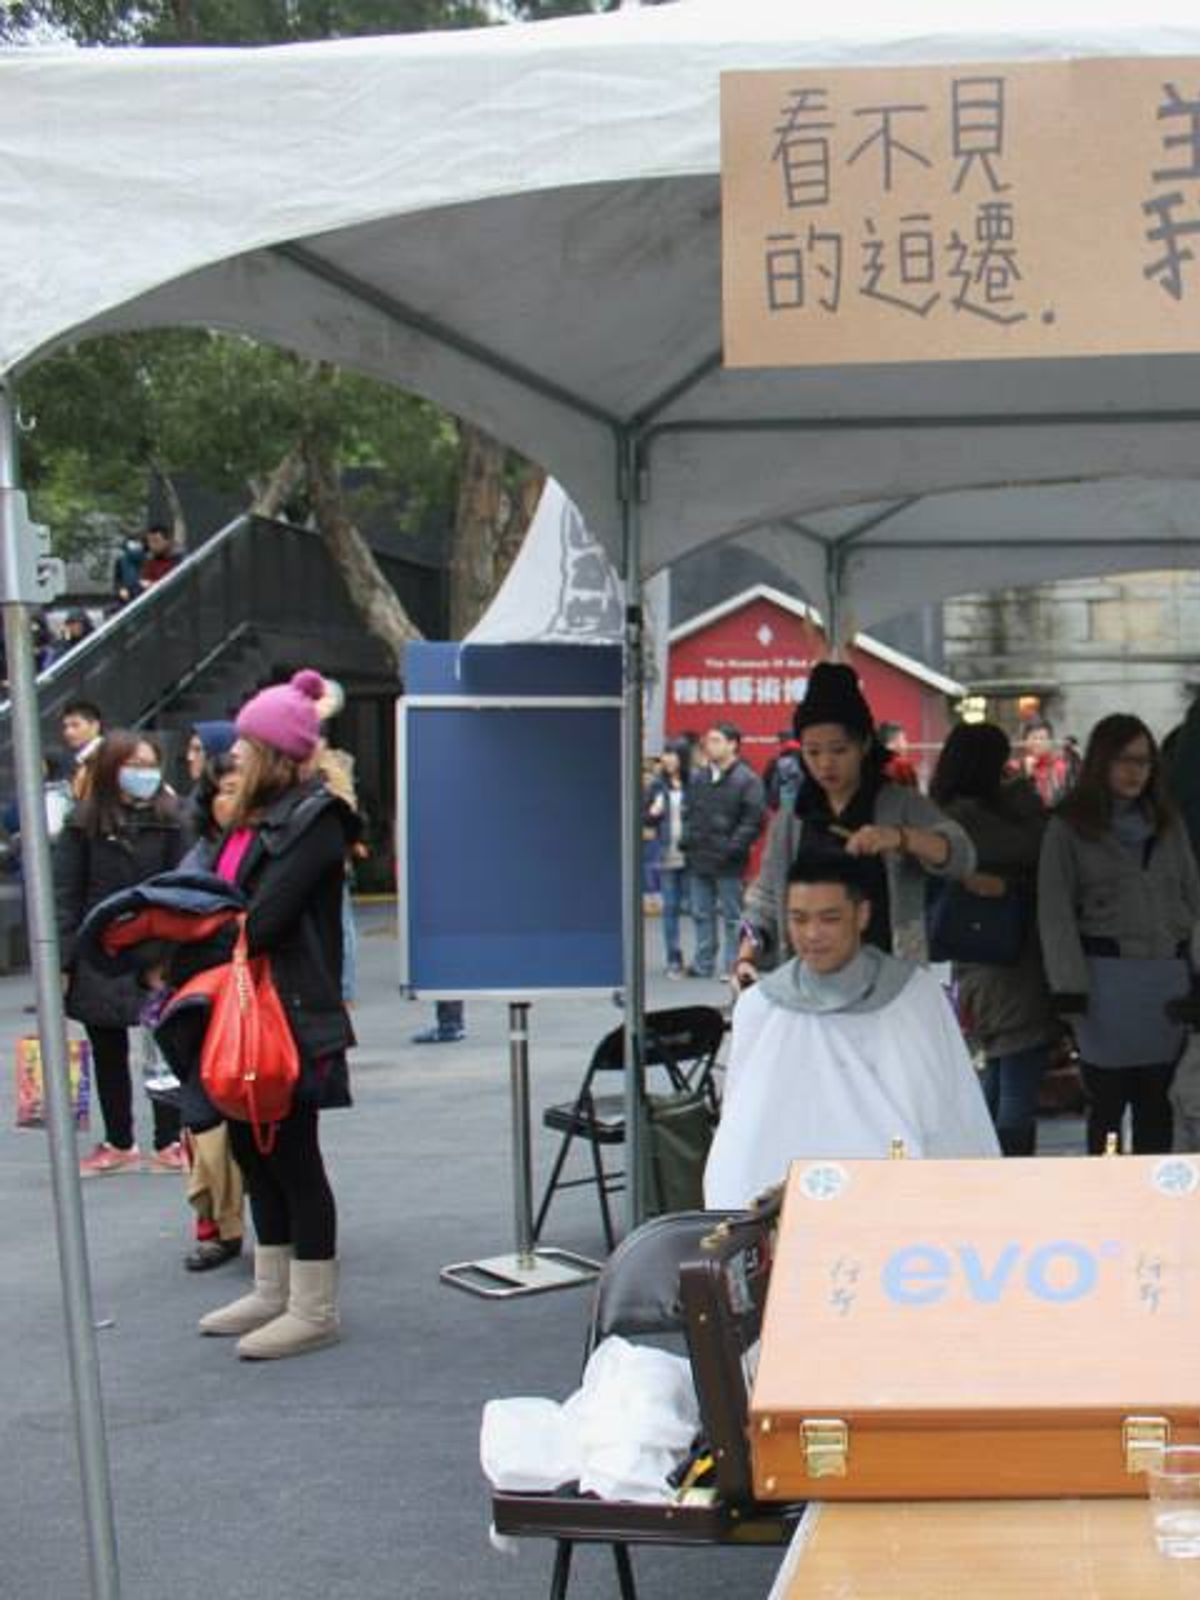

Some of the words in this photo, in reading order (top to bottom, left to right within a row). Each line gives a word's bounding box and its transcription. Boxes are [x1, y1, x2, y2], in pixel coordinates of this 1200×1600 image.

[772, 77, 1013, 208] 看不見
[880, 1240, 1099, 1305] evo
